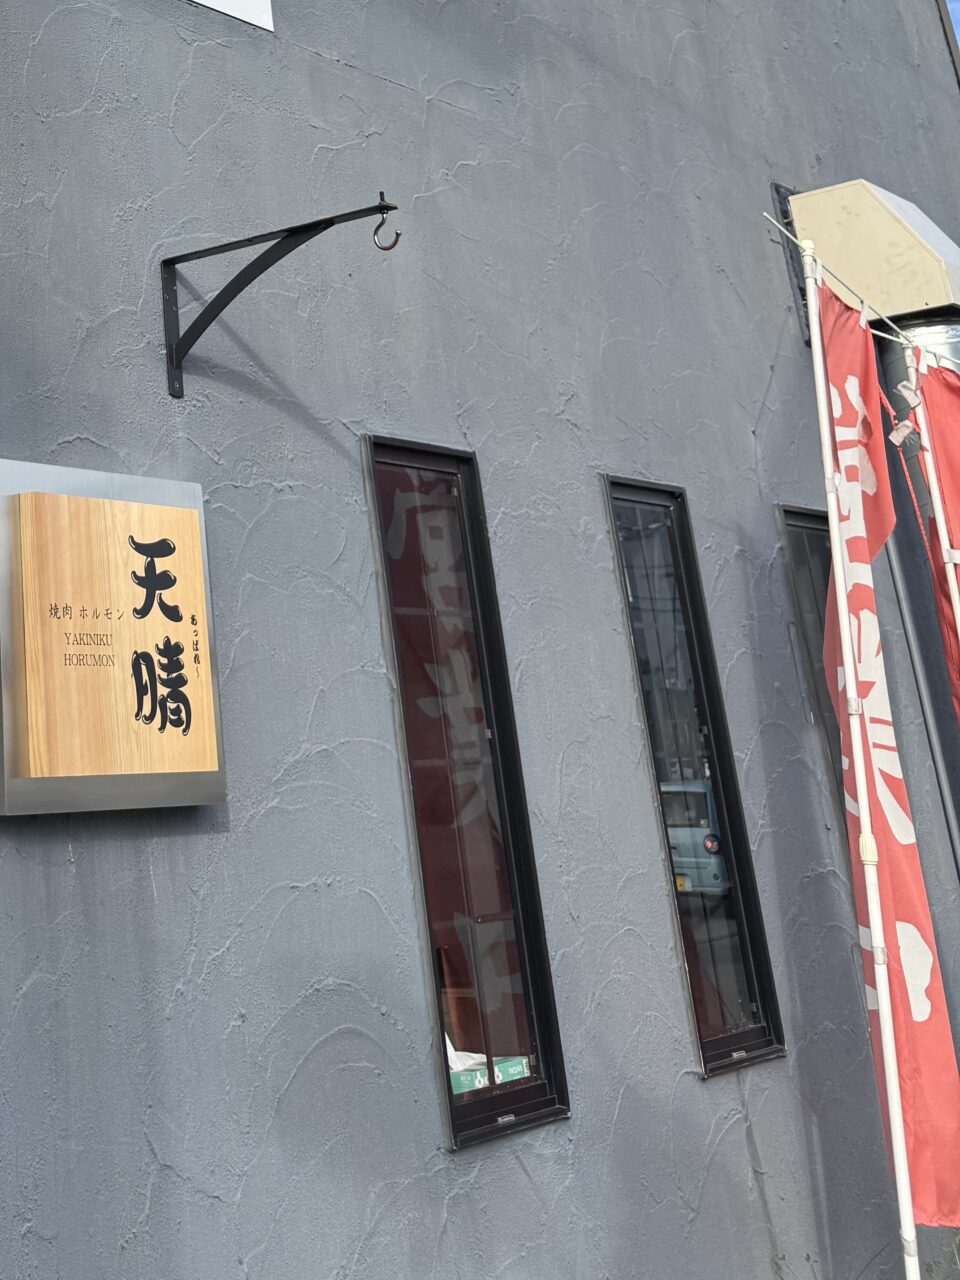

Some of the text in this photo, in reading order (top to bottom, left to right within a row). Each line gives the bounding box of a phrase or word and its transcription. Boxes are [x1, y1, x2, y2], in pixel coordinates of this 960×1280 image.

[48, 602, 125, 621] 焼肉 ホルモン
[64, 632, 113, 647] YAKINIKU
[64, 653, 115, 667] HORUMON
